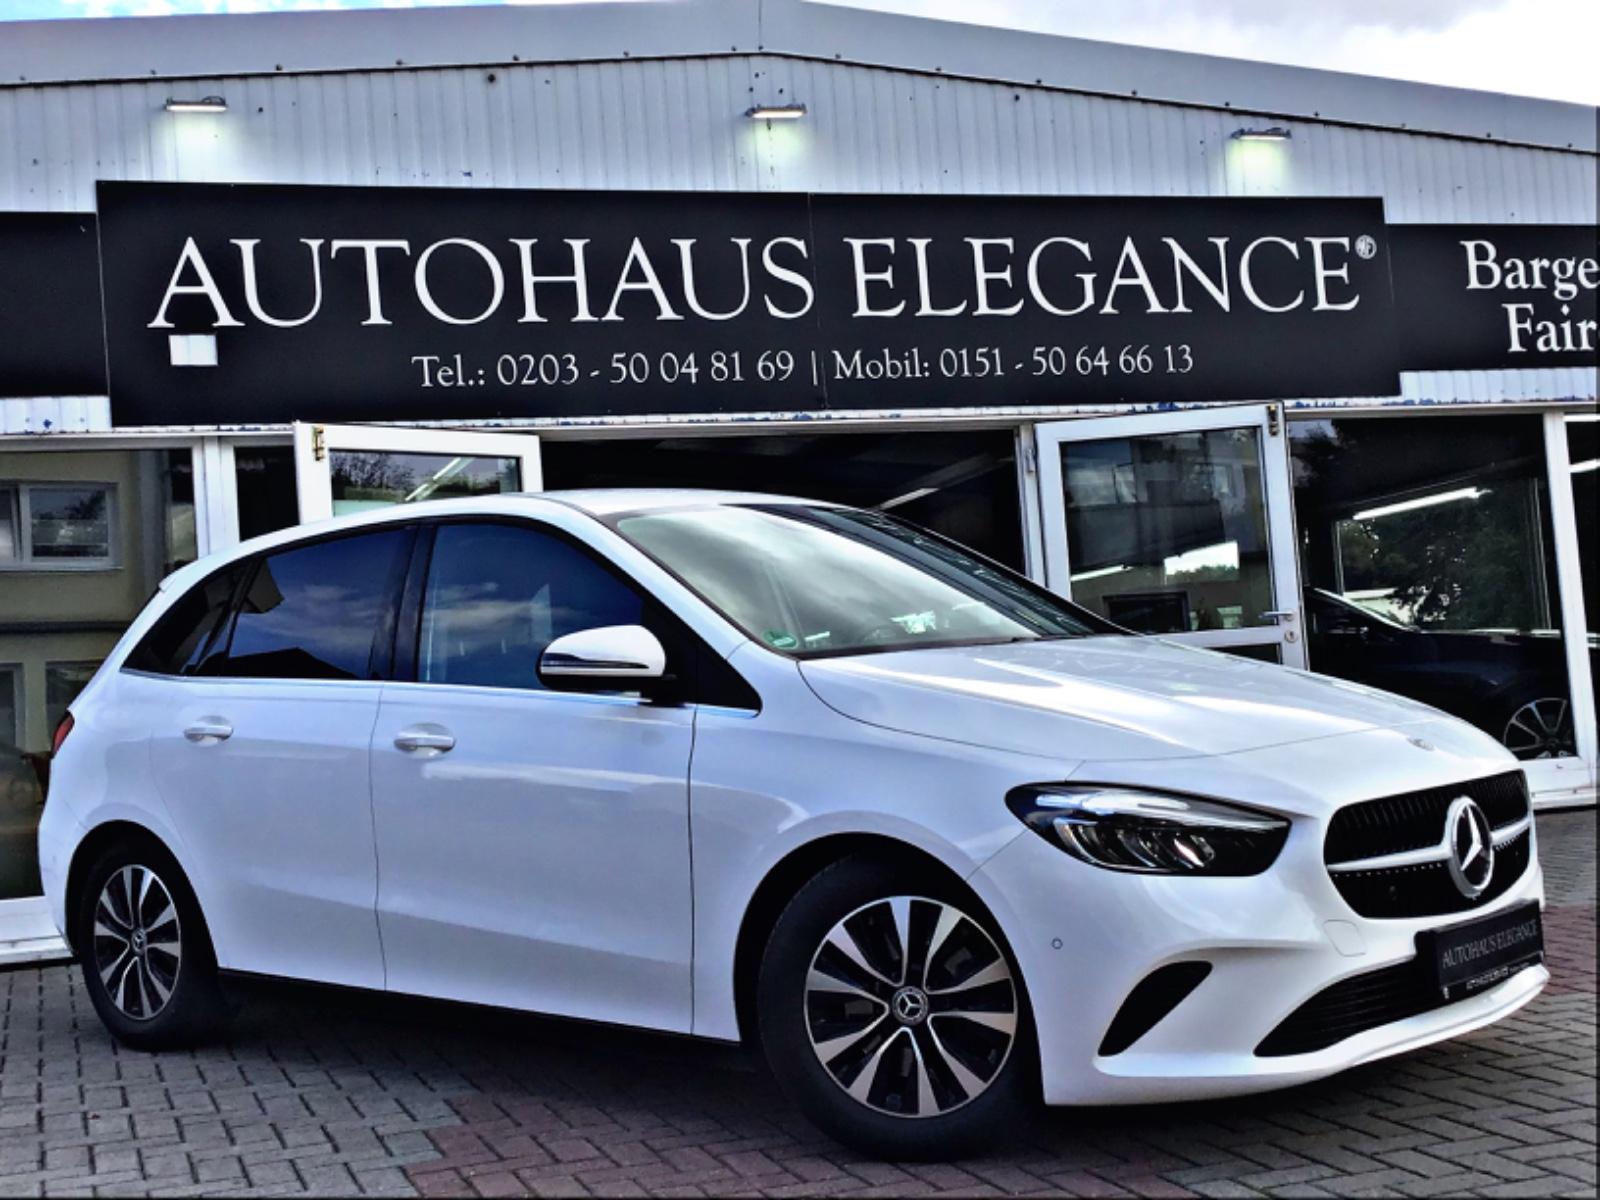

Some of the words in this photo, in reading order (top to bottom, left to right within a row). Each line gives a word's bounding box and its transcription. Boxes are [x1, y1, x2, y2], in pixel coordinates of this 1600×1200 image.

[147, 236, 815, 328] AUTOHAUS
[842, 236, 1360, 318] ELEGANCE
[1459, 239, 1600, 301] Barge
[1501, 303, 1597, 352] Fair
[411, 353, 485, 388] Tel.:
[497, 352, 579, 386] 0203
[610, 352, 650, 384] 50
[659, 352, 699, 384] 04
[710, 351, 744, 382] 81
[757, 350, 794, 381] 69
[831, 347, 930, 379] Mobil:
[939, 347, 1004, 378] 0151
[1032, 346, 1066, 376] 50
[1075, 345, 1110, 376] 64
[1119, 344, 1153, 374] 66
[1164, 344, 1193, 374] 13
